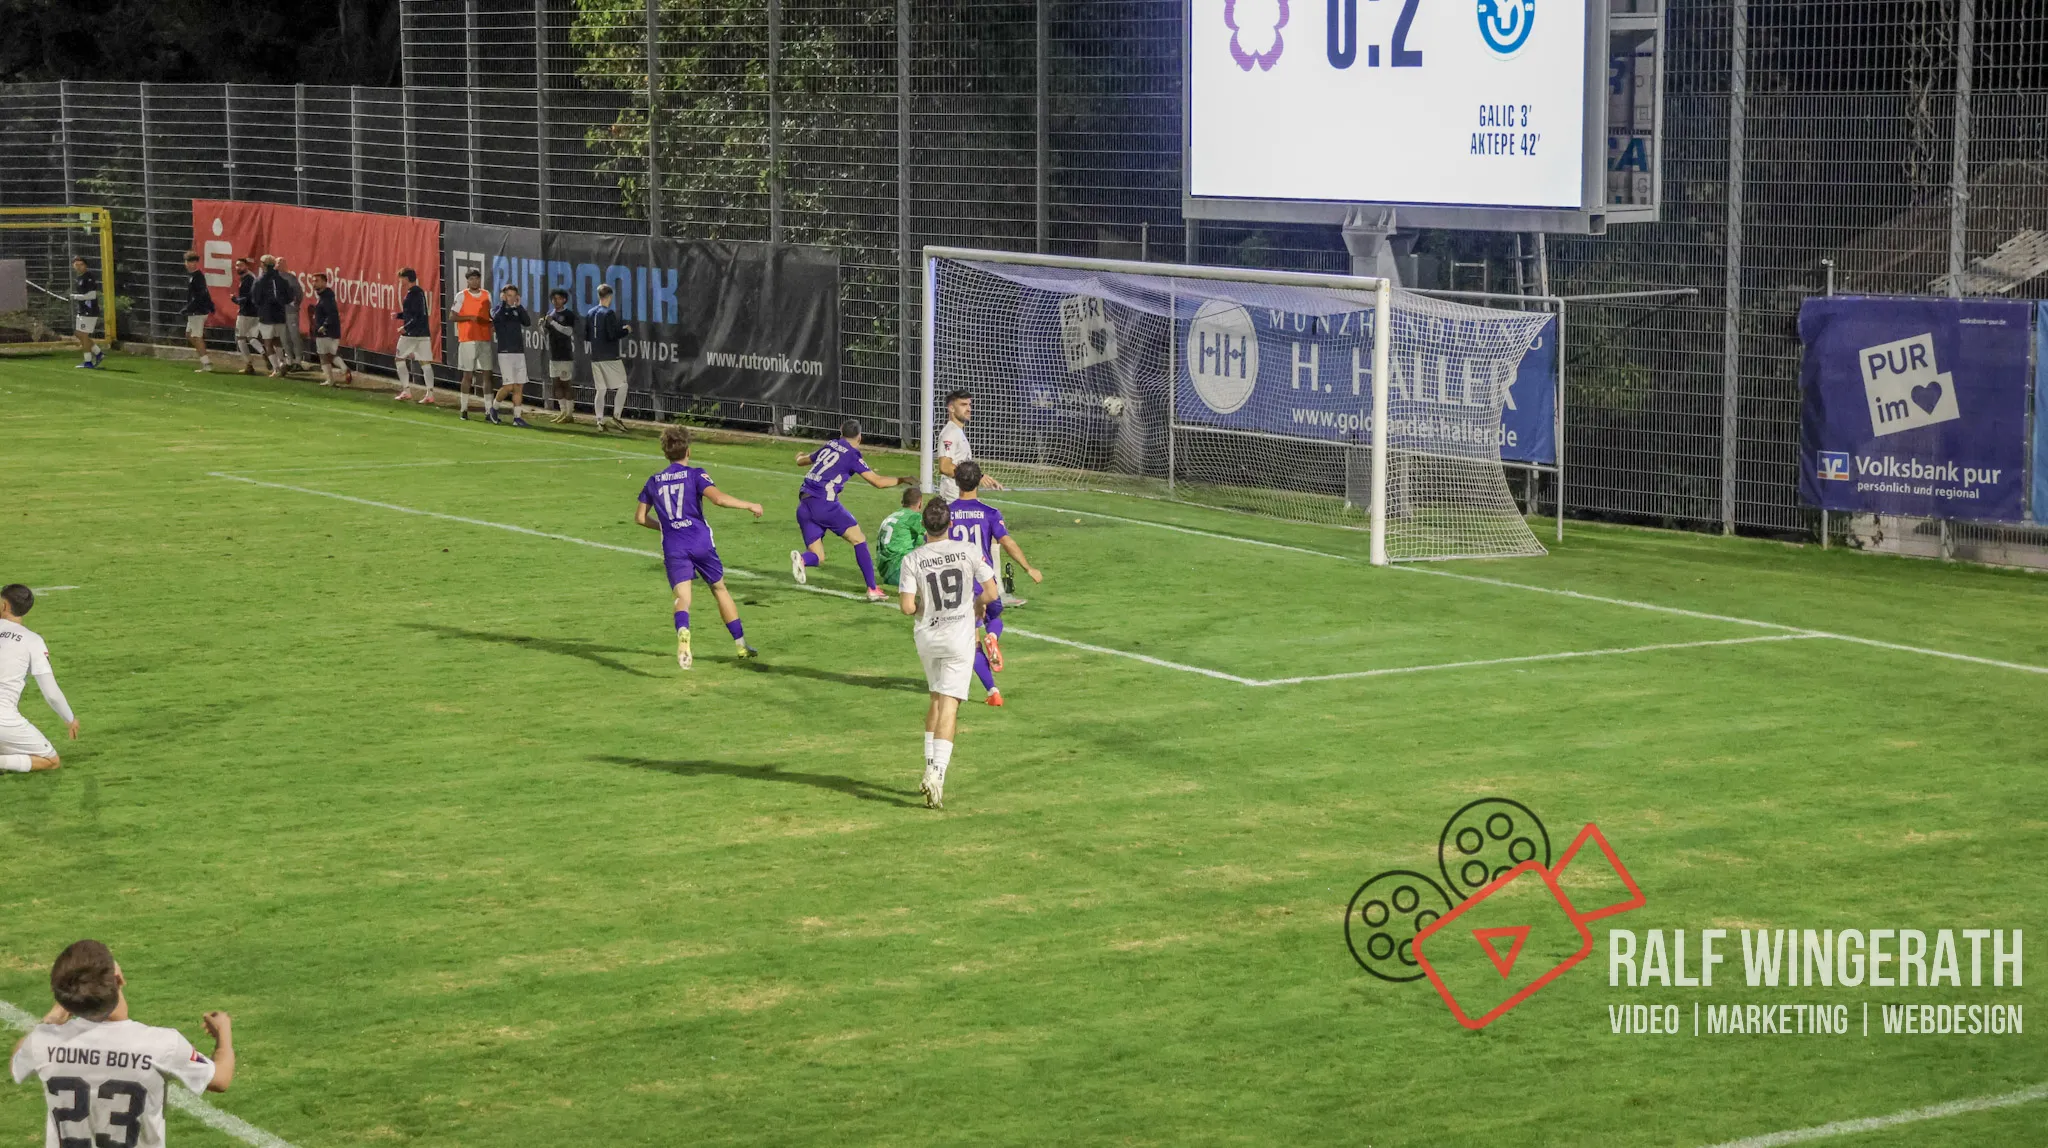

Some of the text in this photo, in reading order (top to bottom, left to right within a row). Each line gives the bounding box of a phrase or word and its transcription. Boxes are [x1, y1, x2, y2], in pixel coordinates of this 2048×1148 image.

[1479, 104, 1515, 127] GALIC
[1470, 132, 1516, 155] AKTEPE
[325, 266, 395, 311] Pforzheim
[492, 255, 679, 325] RUTRONIK
[584, 339, 680, 363] WLDWIDE
[706, 351, 823, 376] www.rutronik.com
[1867, 343, 1929, 381] PUR
[1875, 397, 1910, 424] im
[1855, 456, 2002, 488] Volksbank pur
[658, 483, 685, 521] 17
[1857, 481, 1980, 500] persönlich und regional
[918, 551, 967, 570] YOUNG BOYS
[926, 567, 963, 612] 19
[47, 1046, 153, 1070] YOUNG BOYS
[46, 1076, 148, 1148] 23
